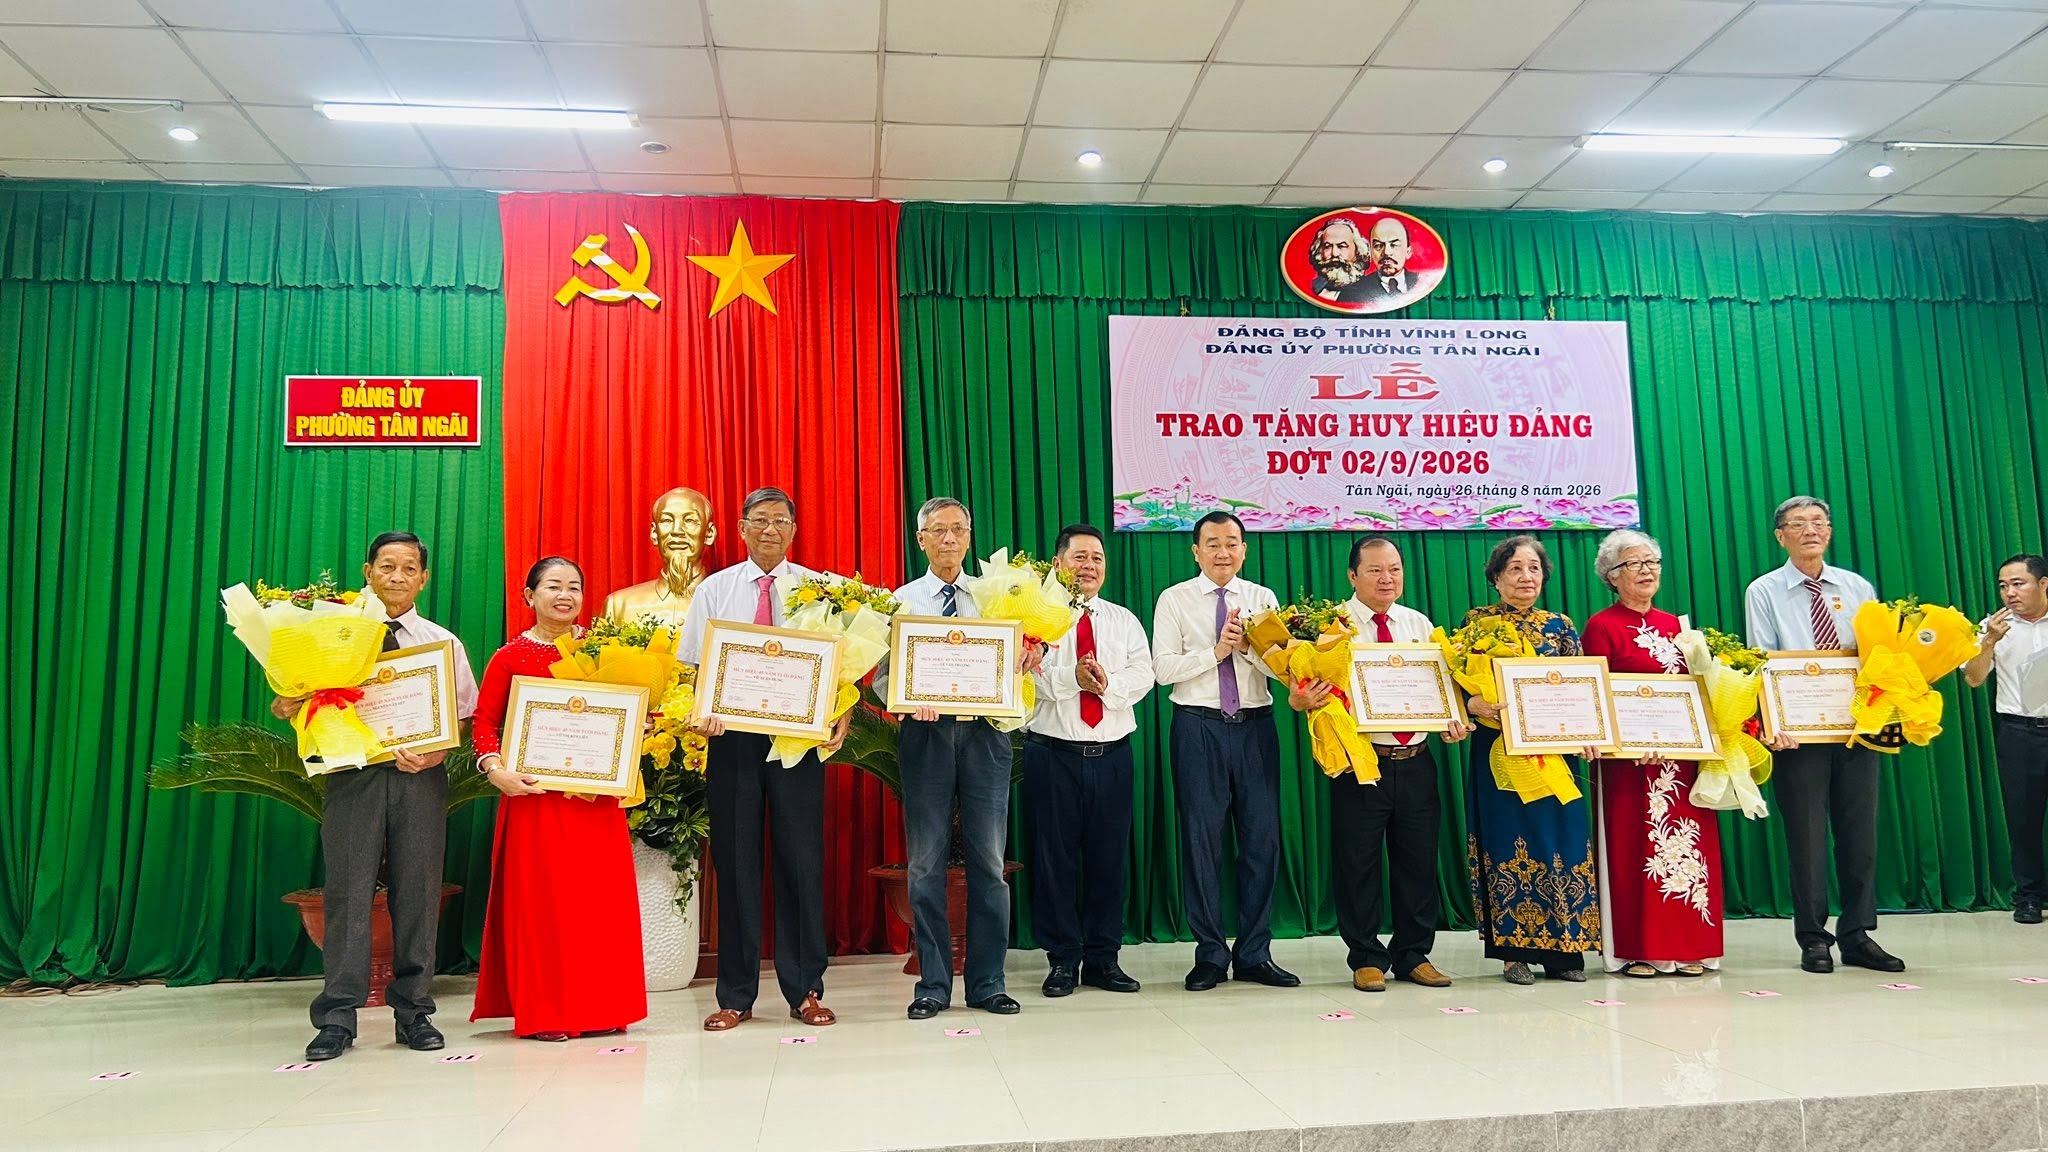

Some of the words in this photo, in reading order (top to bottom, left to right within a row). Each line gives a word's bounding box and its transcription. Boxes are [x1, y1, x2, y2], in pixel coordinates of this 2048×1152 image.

[1217, 324, 1285, 338] ĐẢNG
[1293, 325, 1327, 339] BỘ
[1335, 325, 1391, 338] TỈNH
[1400, 326, 1456, 339] VĨNH
[1466, 330, 1527, 340] LONG
[1205, 341, 1273, 354] ĐẢNG
[1281, 341, 1313, 354] ỦY
[1323, 342, 1421, 355] PHƯỜNG
[1429, 344, 1477, 355] TÂN
[1486, 344, 1541, 356] NGÃI
[341, 379, 395, 408] ĐẢNG
[399, 379, 425, 408] ỦY
[1310, 362, 1440, 400] LỄ
[295, 411, 376, 437] PHƯỜNG
[379, 412, 418, 437] TÂN
[422, 412, 469, 437] NGÃI
[1156, 413, 1244, 437] TRAO
[1253, 408, 1339, 443] TẶNG
[1348, 413, 1413, 437] HUY
[1423, 409, 1499, 443] HIỆU
[1508, 406, 1593, 437] ĐẢNG
[1267, 446, 1332, 480] ĐỢT
[1342, 450, 1490, 477] 02/9/2026
[1345, 484, 1372, 496] Tân
[1376, 484, 1412, 498] Ngãi,
[1416, 485, 1451, 499] ngày
[1455, 485, 1473, 496] 26
[1477, 484, 1517, 499] tháng
[1521, 485, 1529, 496] 8
[1533, 486, 1563, 496] năm
[1567, 485, 1601, 496] 2026
